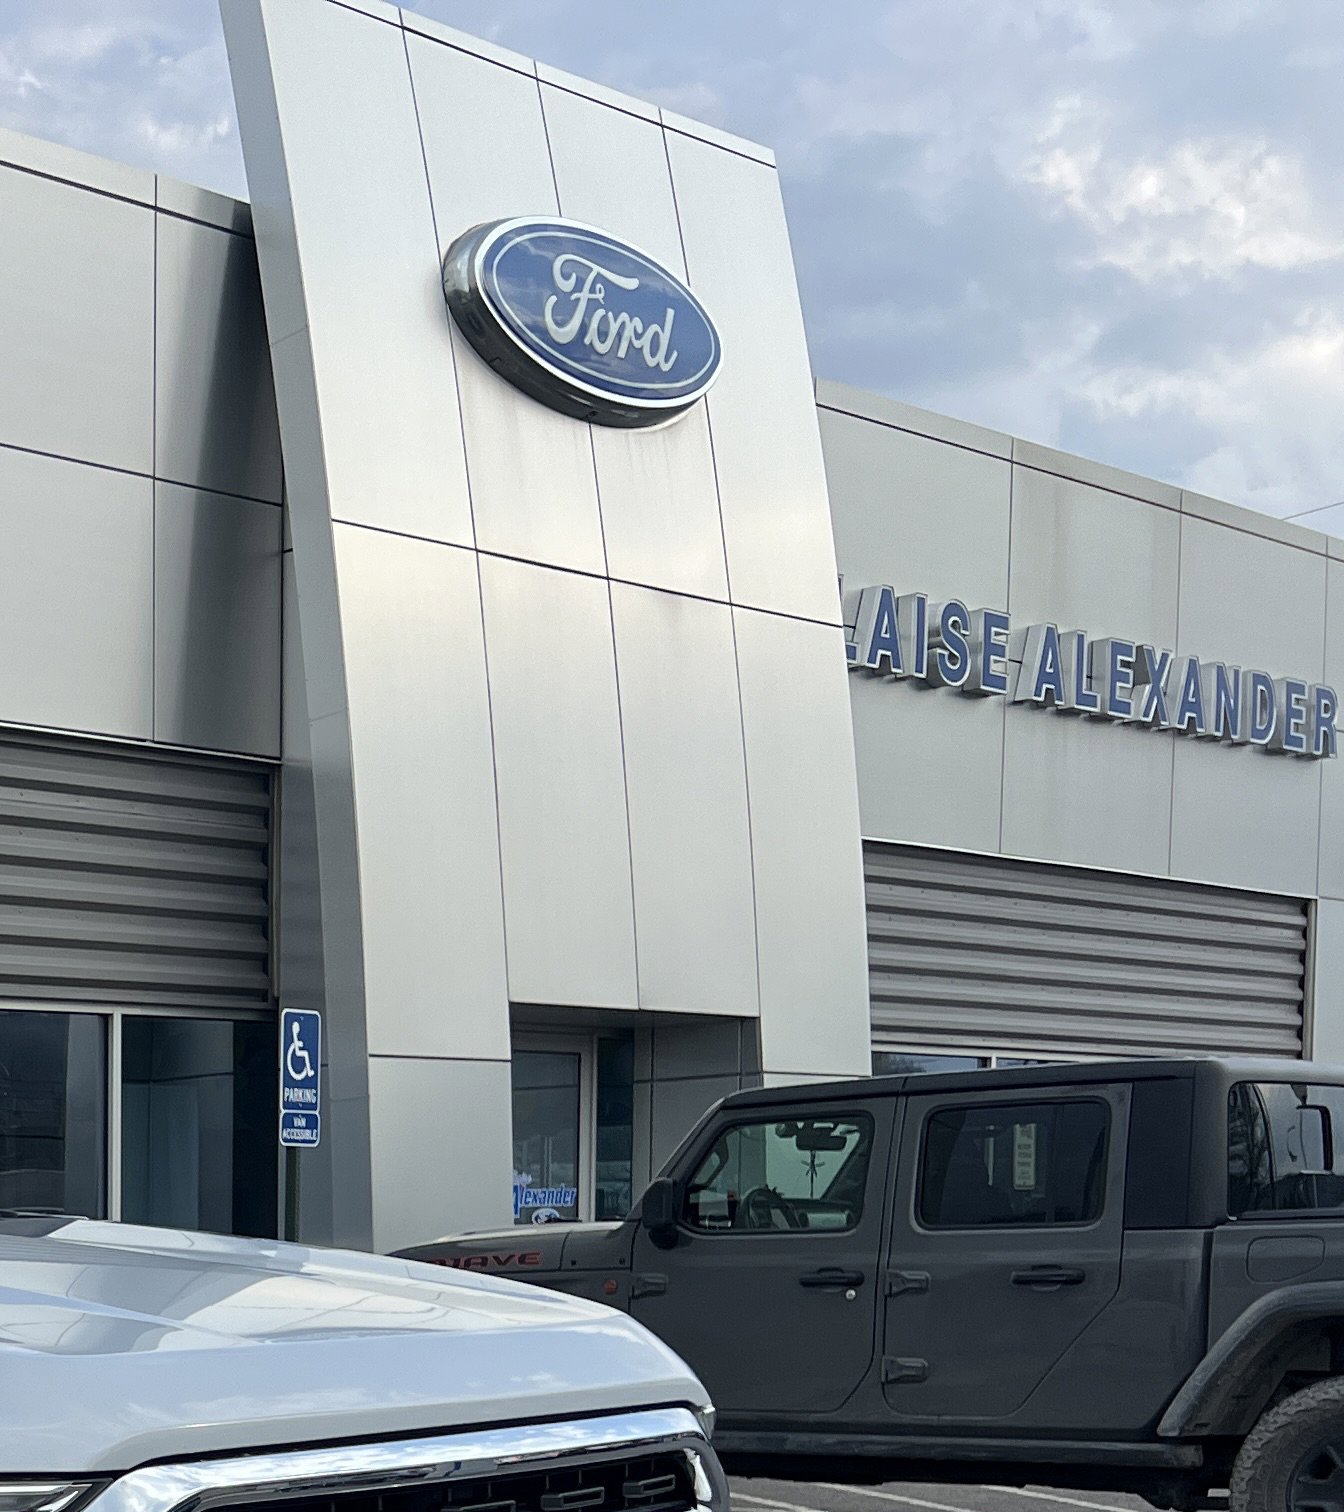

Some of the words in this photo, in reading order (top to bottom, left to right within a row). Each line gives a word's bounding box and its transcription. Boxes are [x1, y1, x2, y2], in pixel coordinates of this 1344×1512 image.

[544, 253, 678, 372] Ford
[1024, 622, 1339, 758] ALEXANDER
[284, 1087, 317, 1104] PARKING
[293, 1116, 307, 1128] VAN
[283, 1128, 318, 1141] ACCESSIBLE
